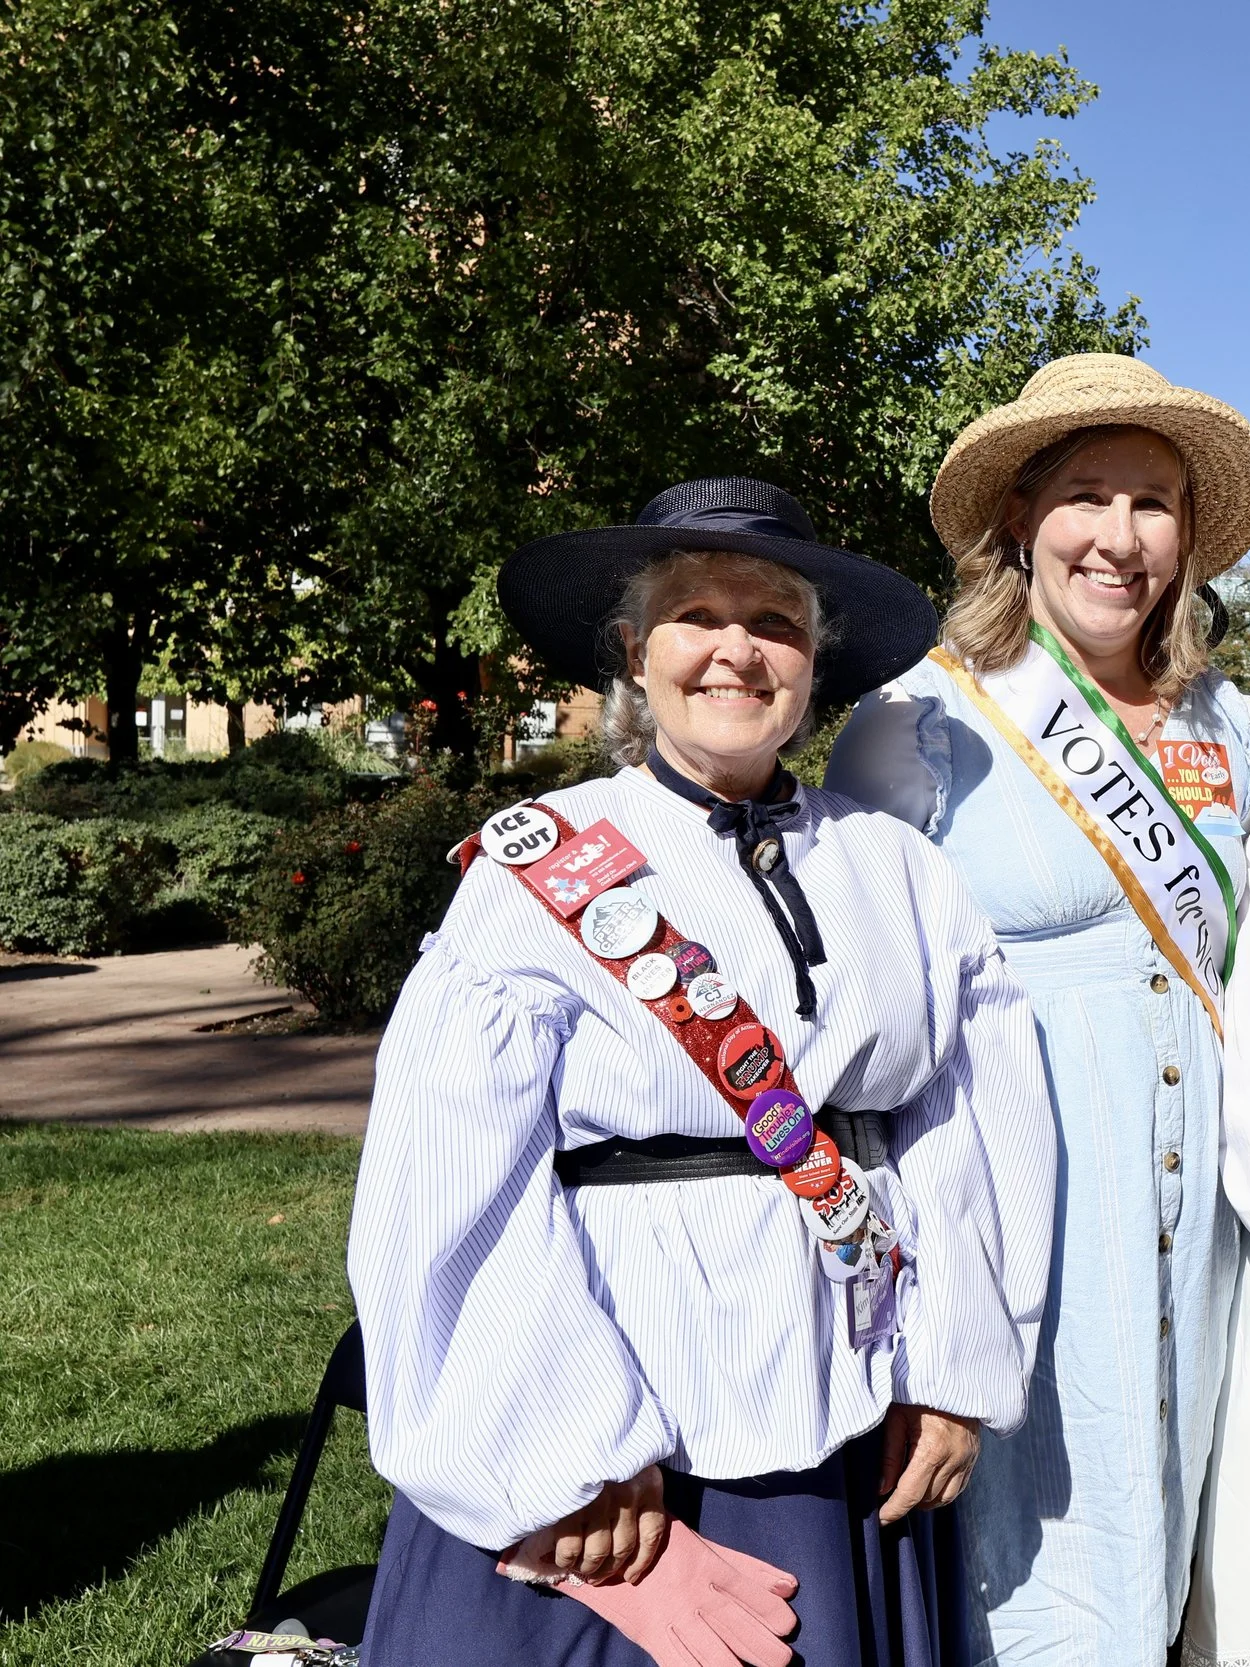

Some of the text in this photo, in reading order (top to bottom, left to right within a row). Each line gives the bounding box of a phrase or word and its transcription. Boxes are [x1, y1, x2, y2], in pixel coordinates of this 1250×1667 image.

[1163, 745, 1176, 769] I
[1210, 770, 1225, 780] Early
[1168, 786, 1213, 802] SHOULD
[491, 811, 531, 837] ICE
[1041, 699, 1175, 862] VOTES
[1164, 865, 1203, 925] for
[503, 827, 552, 858] OUT
[563, 834, 611, 873] vote!
[548, 853, 572, 872] register
[595, 902, 631, 942] PETER
[631, 957, 656, 981] BLACK
[680, 952, 710, 977] ULTURE
[683, 955, 695, 967] your
[640, 964, 662, 985] LIVES
[699, 993, 735, 1013] HERNANDEZ
[704, 988, 722, 1002] CJ
[721, 1044, 729, 1067] National
[727, 1034, 736, 1042] Day
[736, 1050, 759, 1077] FIGHT THE
[735, 1047, 769, 1087] TRUMP
[747, 1059, 770, 1085] TAKEOVER
[754, 1108, 779, 1134] Good
[761, 1108, 792, 1141] Trouble
[766, 1113, 801, 1150] Lives On
[793, 1156, 833, 1174] WEAVER
[812, 1168, 854, 1216] SOS
